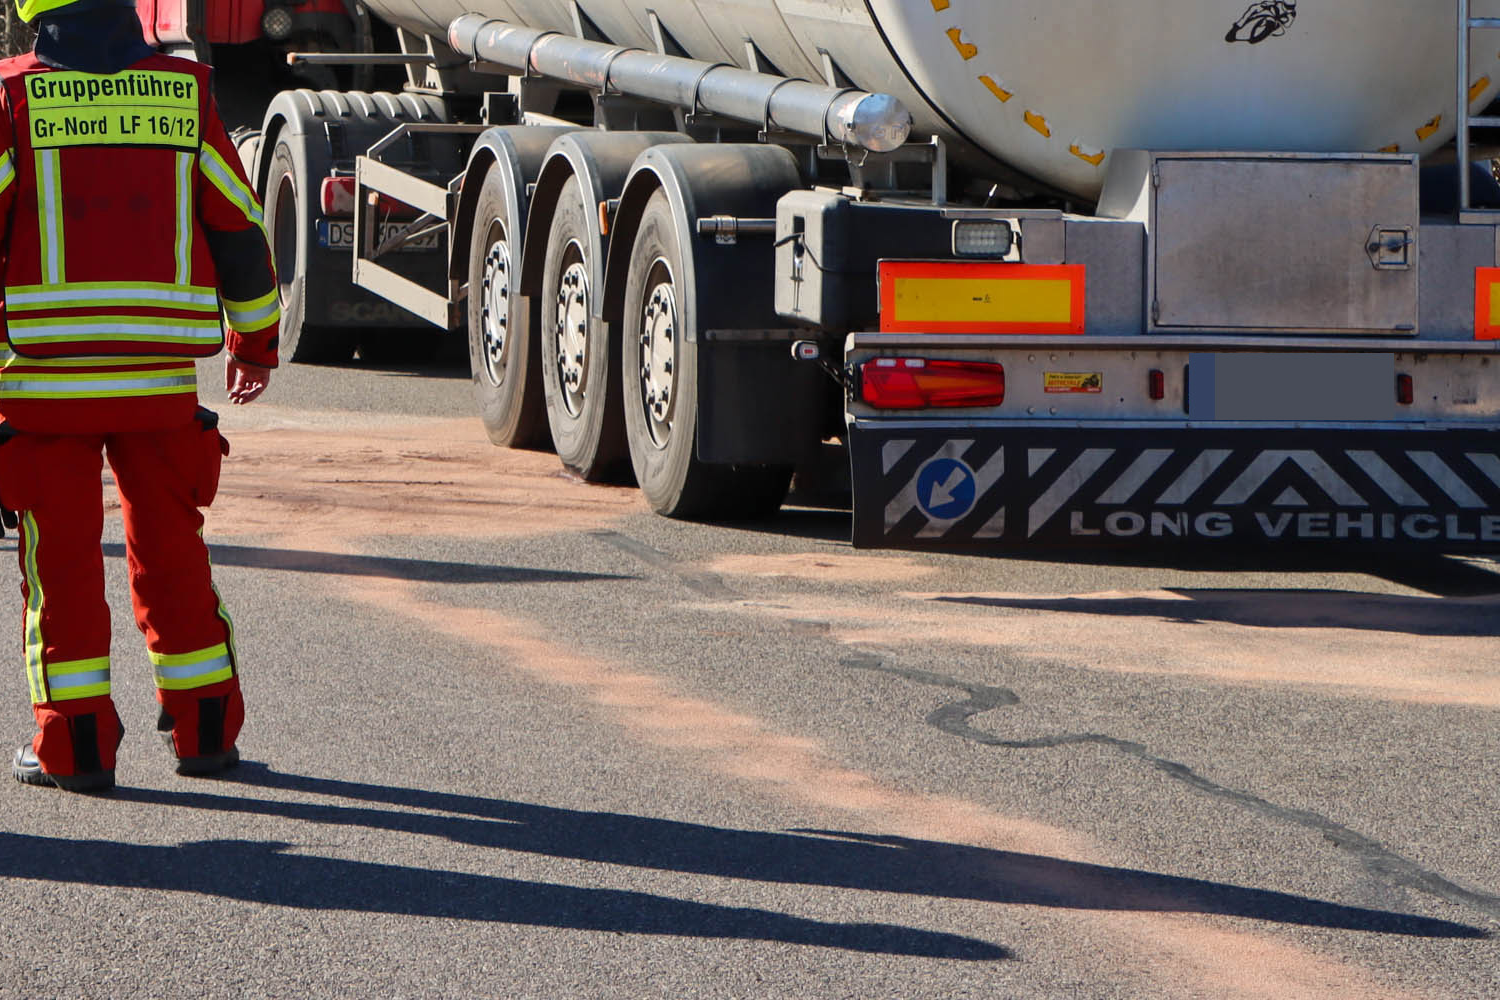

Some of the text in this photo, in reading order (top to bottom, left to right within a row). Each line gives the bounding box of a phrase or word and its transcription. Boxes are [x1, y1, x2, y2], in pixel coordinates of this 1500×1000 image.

[30, 74, 194, 102] Gruppenführer
[34, 115, 195, 138] Gr-Nord LF 16/12
[1070, 511, 1500, 541] LONG VEHICLE
